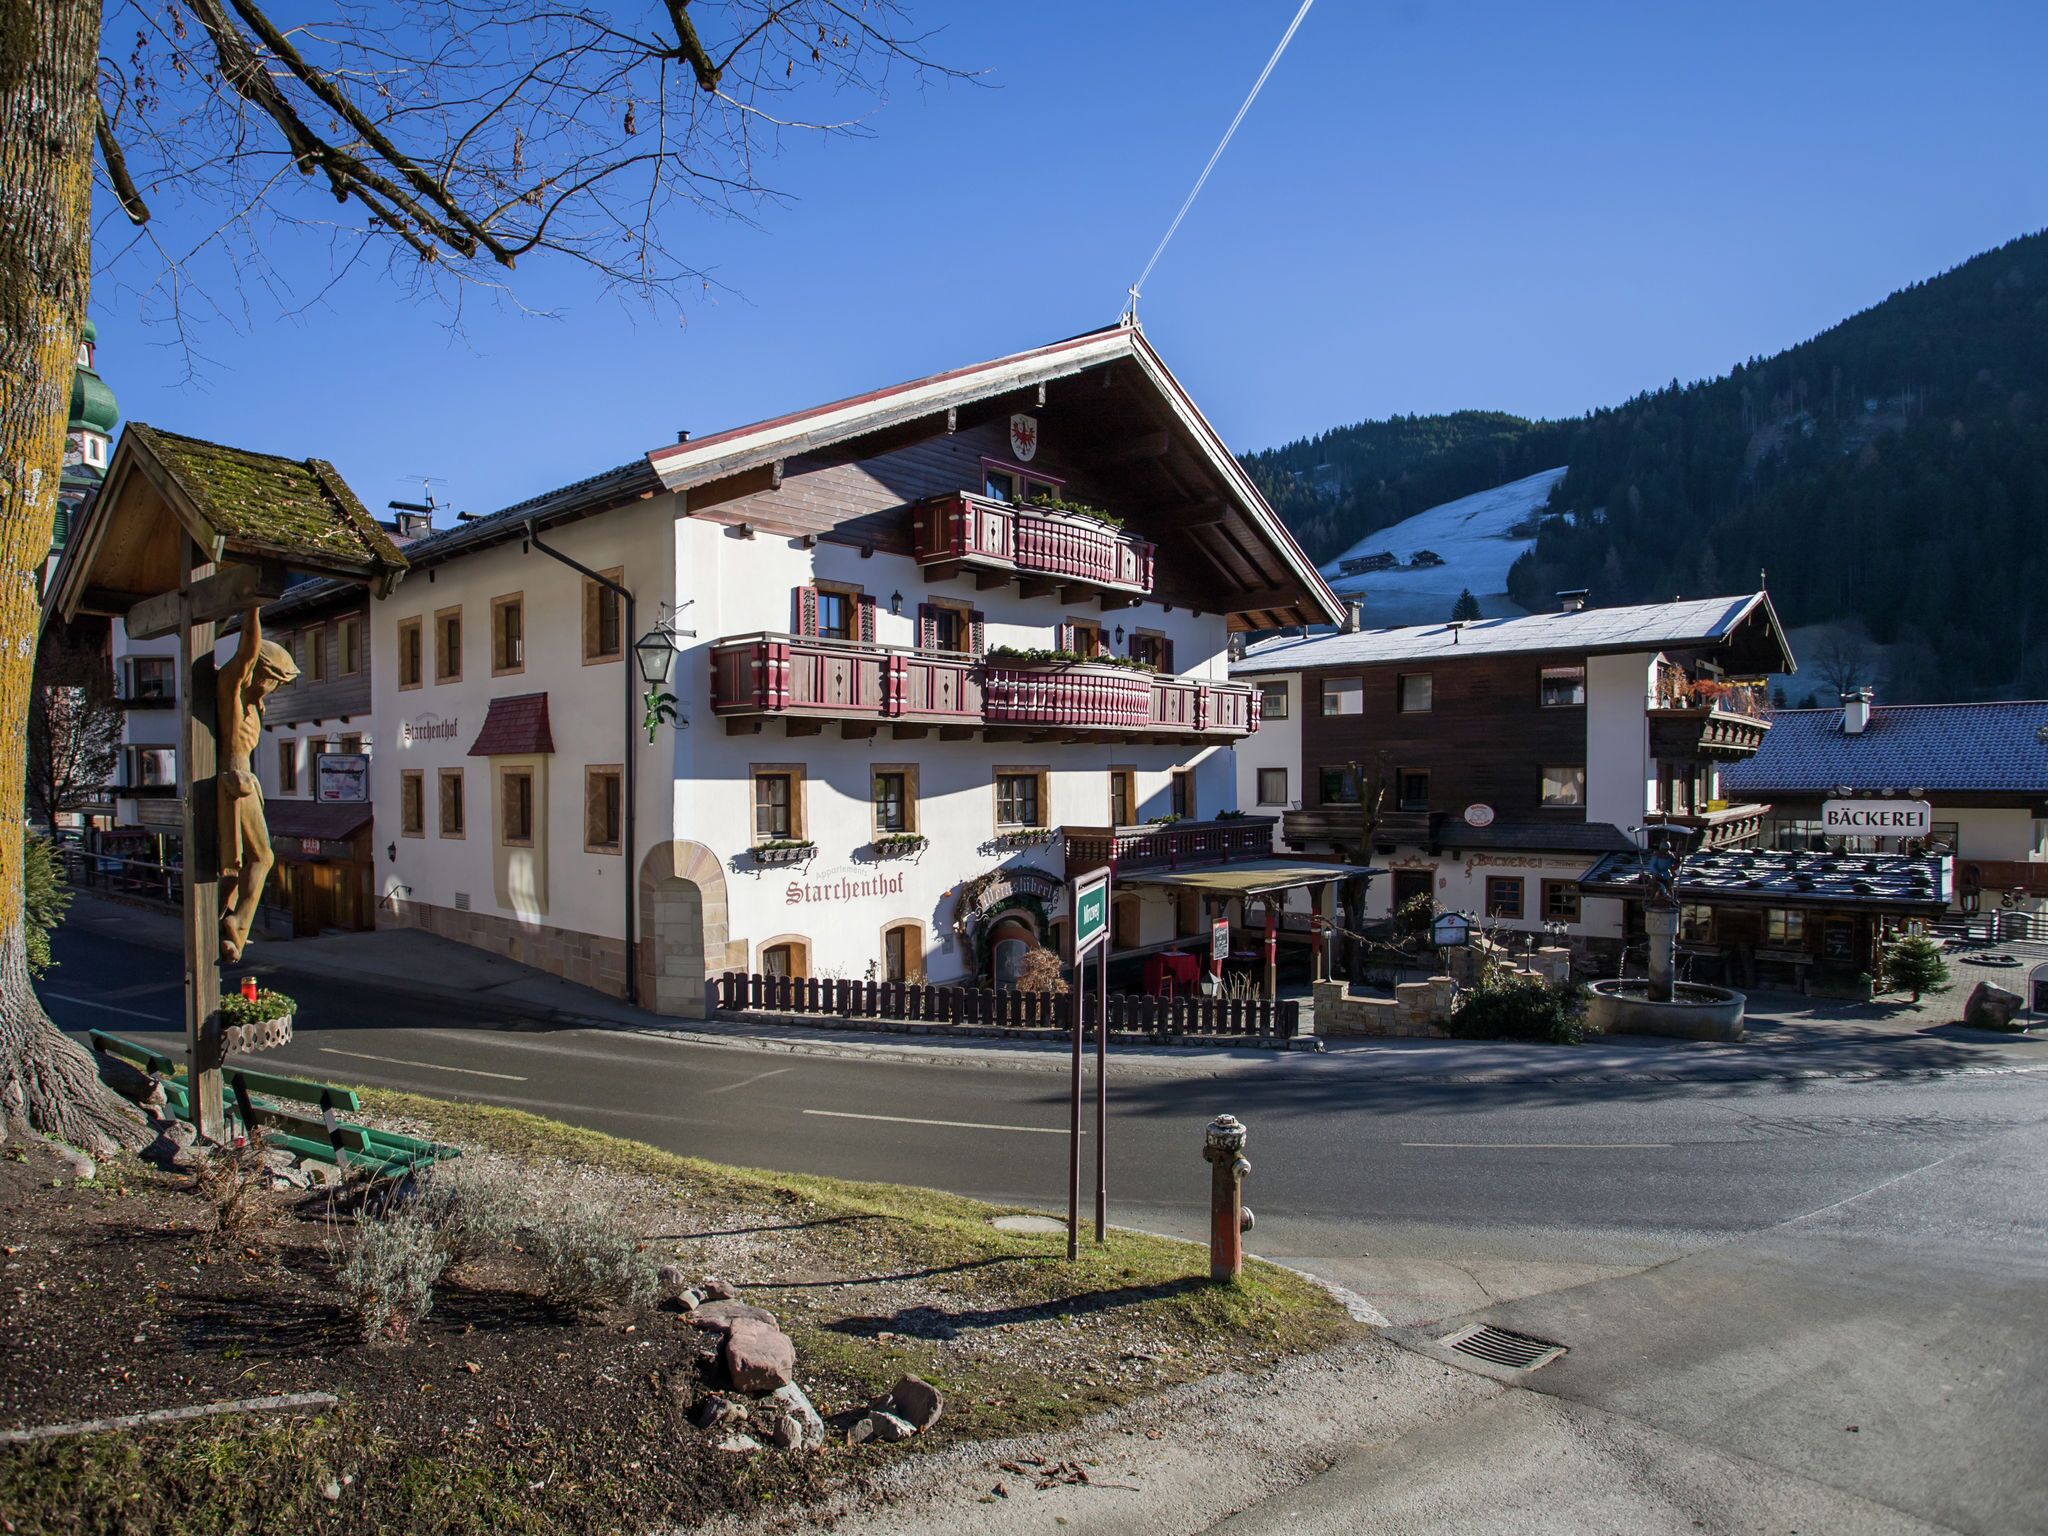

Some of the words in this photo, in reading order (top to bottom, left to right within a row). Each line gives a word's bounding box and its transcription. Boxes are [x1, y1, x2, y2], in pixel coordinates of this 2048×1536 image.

[404, 717, 458, 743] Starchenthof
[1827, 807, 1924, 827] BÄCKEREI
[785, 872, 903, 905] Starchenthof
